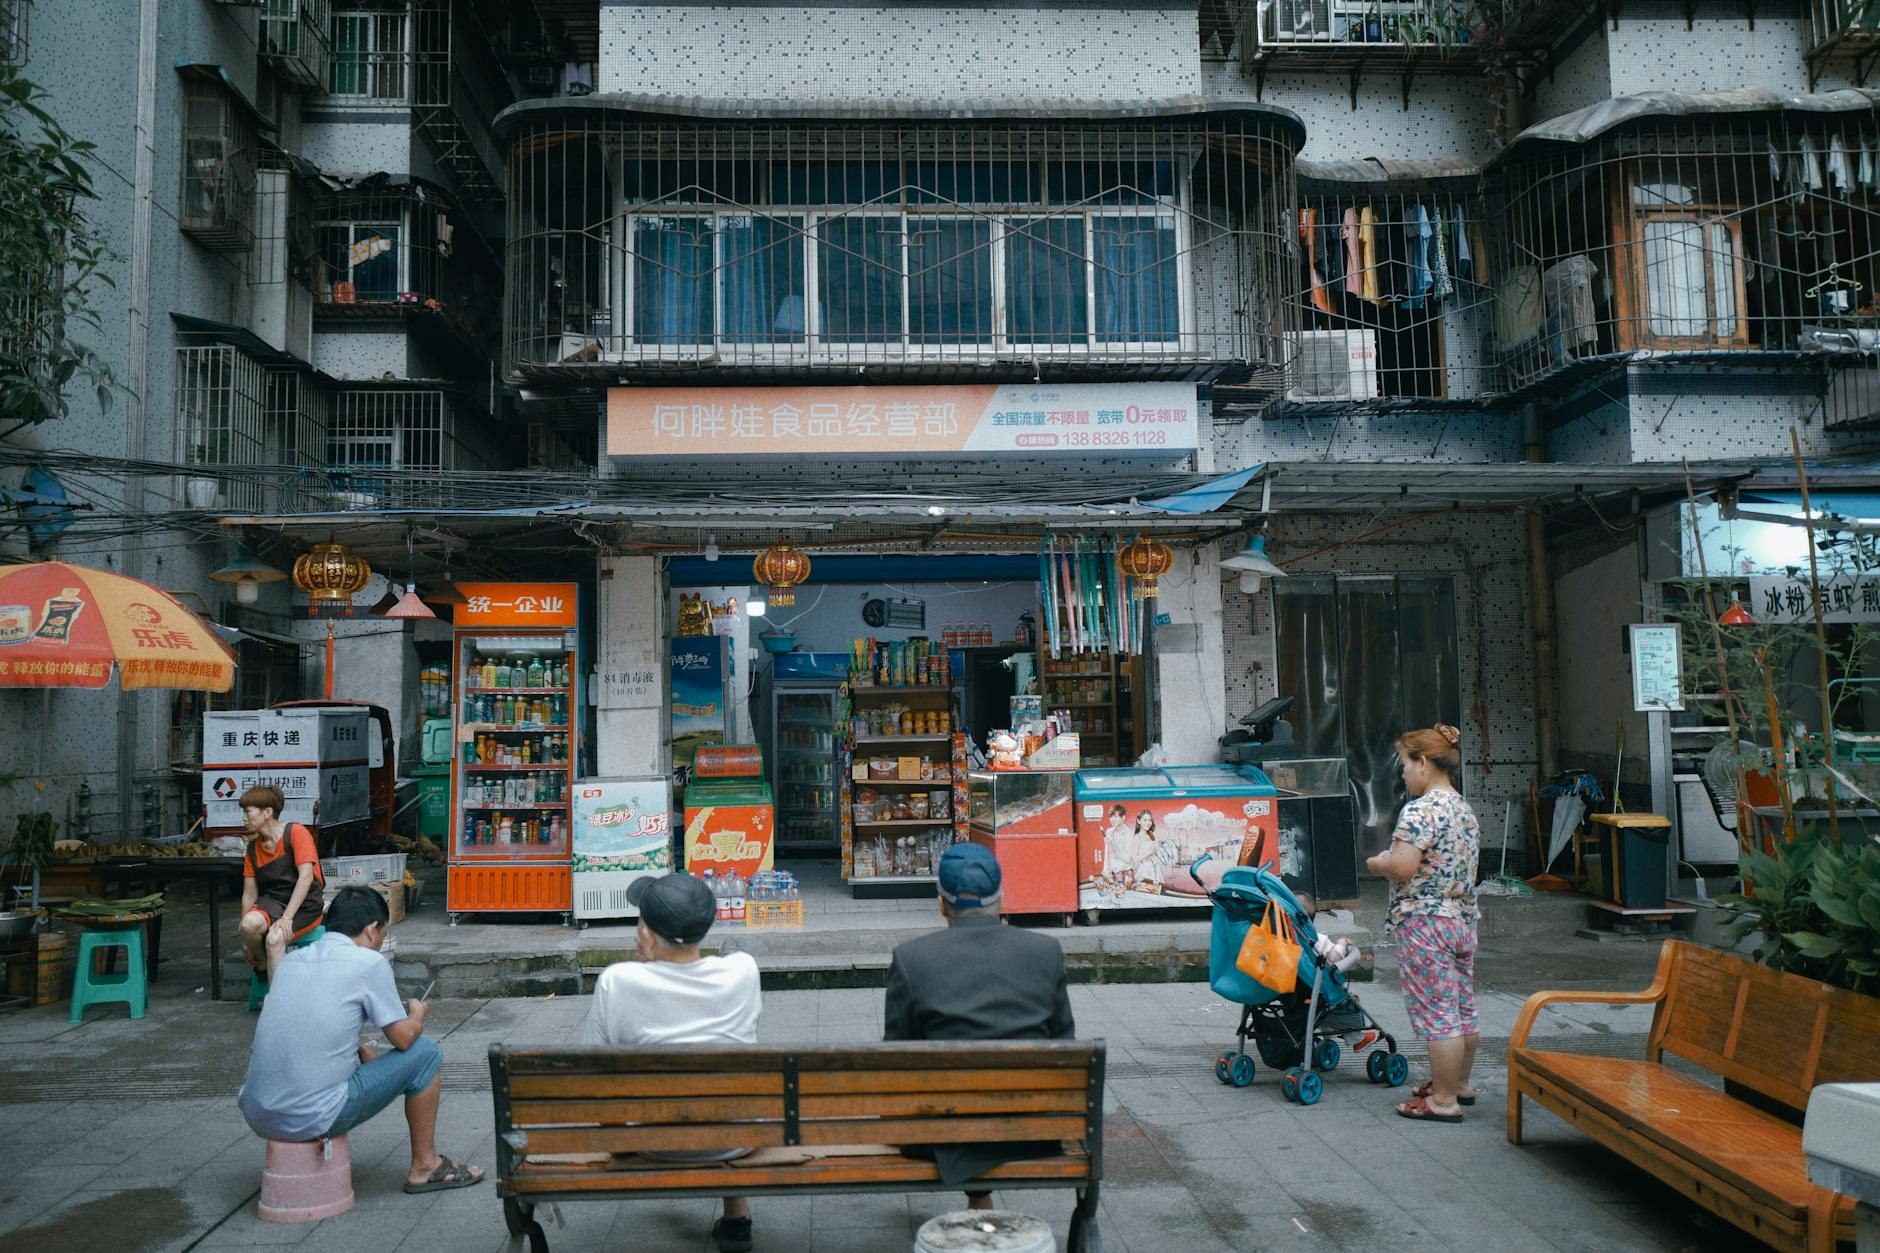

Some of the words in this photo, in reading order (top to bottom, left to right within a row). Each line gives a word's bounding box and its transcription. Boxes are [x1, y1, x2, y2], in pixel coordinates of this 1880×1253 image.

[650, 403, 957, 438] 何胖娃食品经营部
[992, 411, 1090, 426] 全国流量不限量
[1096, 405, 1188, 424] 宽带0元领取
[1063, 431, 1089, 446] 138
[1093, 431, 1129, 446] 8326
[1134, 430, 1166, 445] 1128
[467, 596, 563, 613] 统一企业
[1764, 586, 1805, 616] 冰粉
[1154, 615, 1170, 625] 1-13
[131, 629, 199, 650] 乐虎
[14, 661, 104, 677] 释放你的能量
[154, 660, 223, 678] 释放你的能量
[620, 671, 655, 684] 消毒液
[222, 730, 300, 747] 重庆快递
